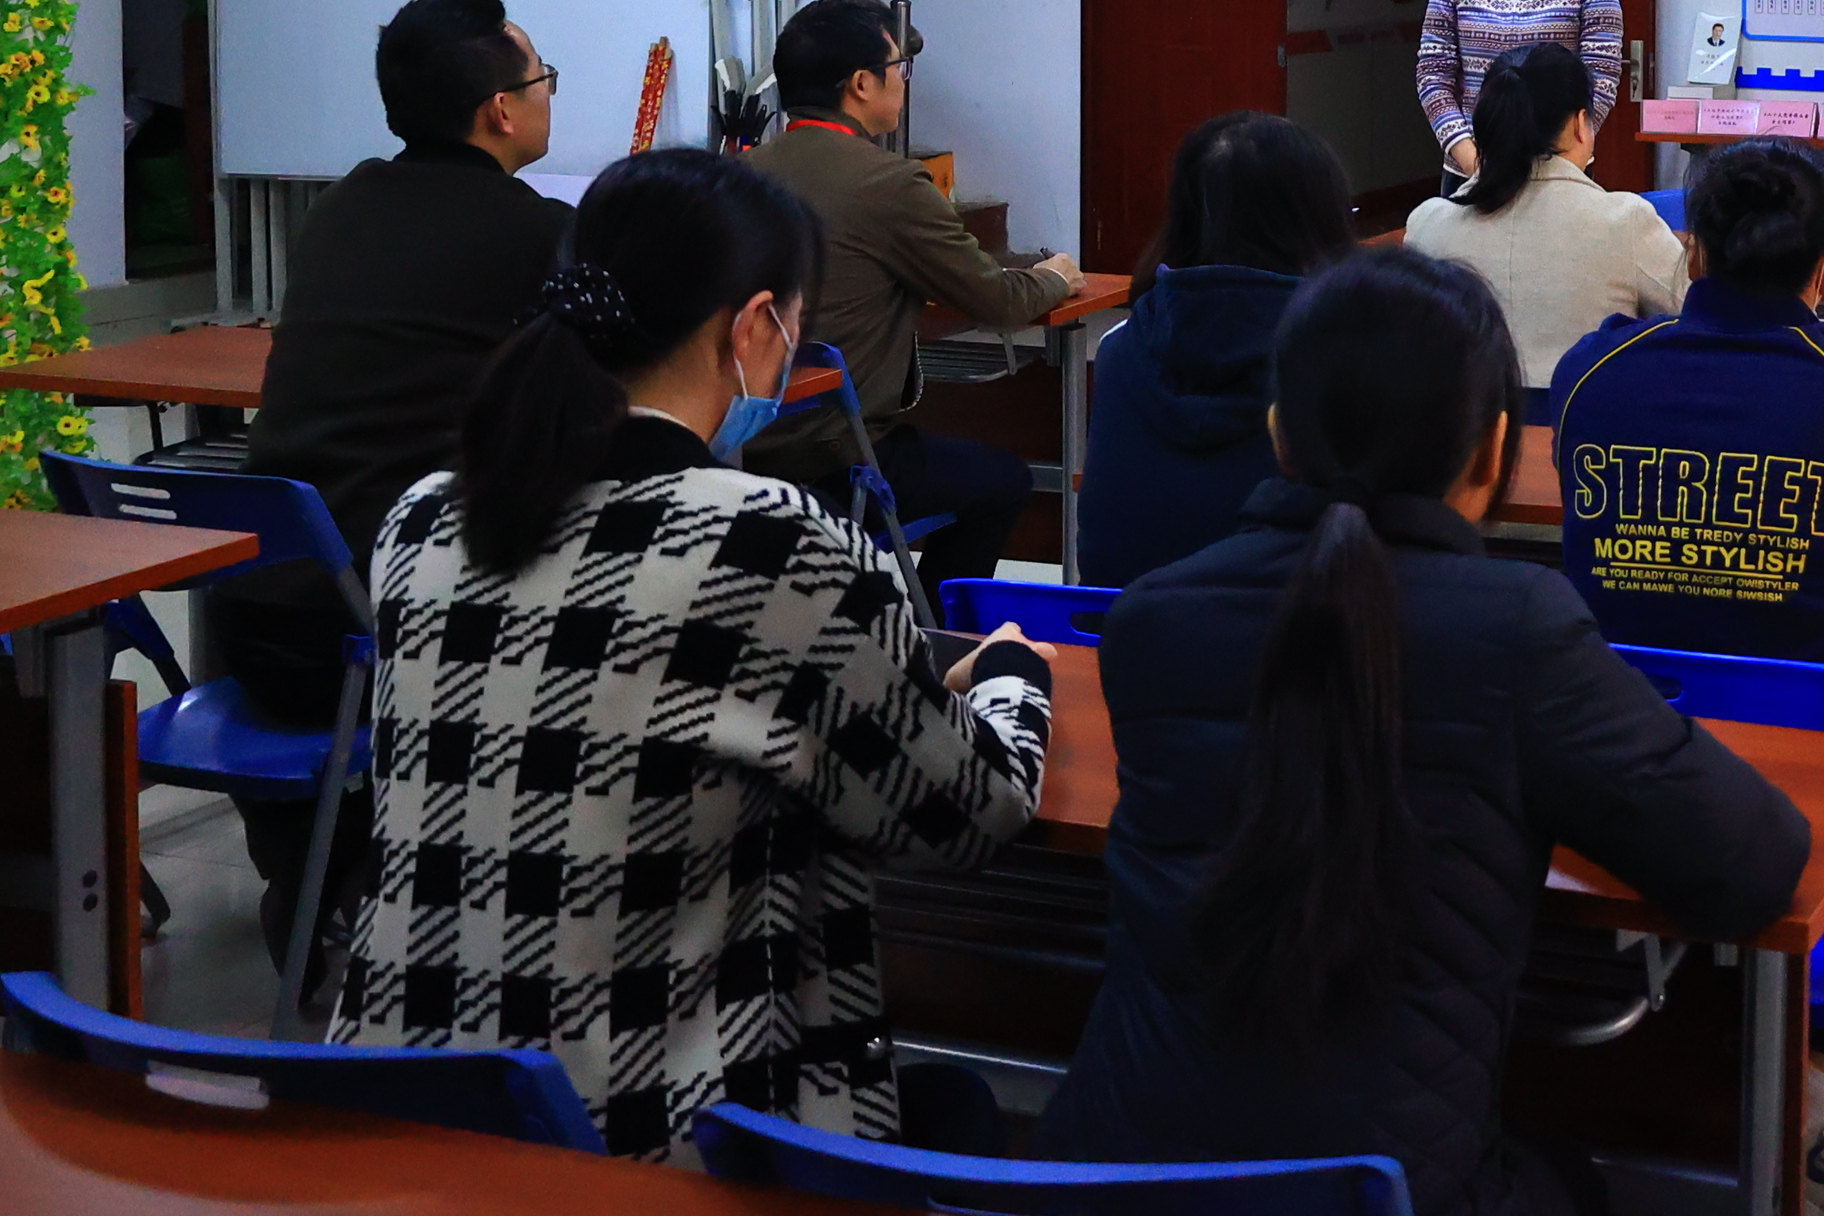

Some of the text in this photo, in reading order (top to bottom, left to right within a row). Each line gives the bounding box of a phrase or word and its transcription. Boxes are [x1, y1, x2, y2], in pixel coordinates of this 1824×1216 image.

[1615, 523, 1810, 551] WANNA BE TREDY STYLISH
[1594, 537, 1807, 574] MORE STYLISH
[1591, 566, 1607, 577] ARE
[1609, 567, 1629, 579] YOU
[1630, 569, 1666, 581] READY
[1668, 571, 1689, 582] FOR
[1692, 574, 1734, 586] ACCEPT
[1602, 580, 1616, 590] WE
[1618, 580, 1640, 591] CAN
[1677, 585, 1700, 596] YOU
